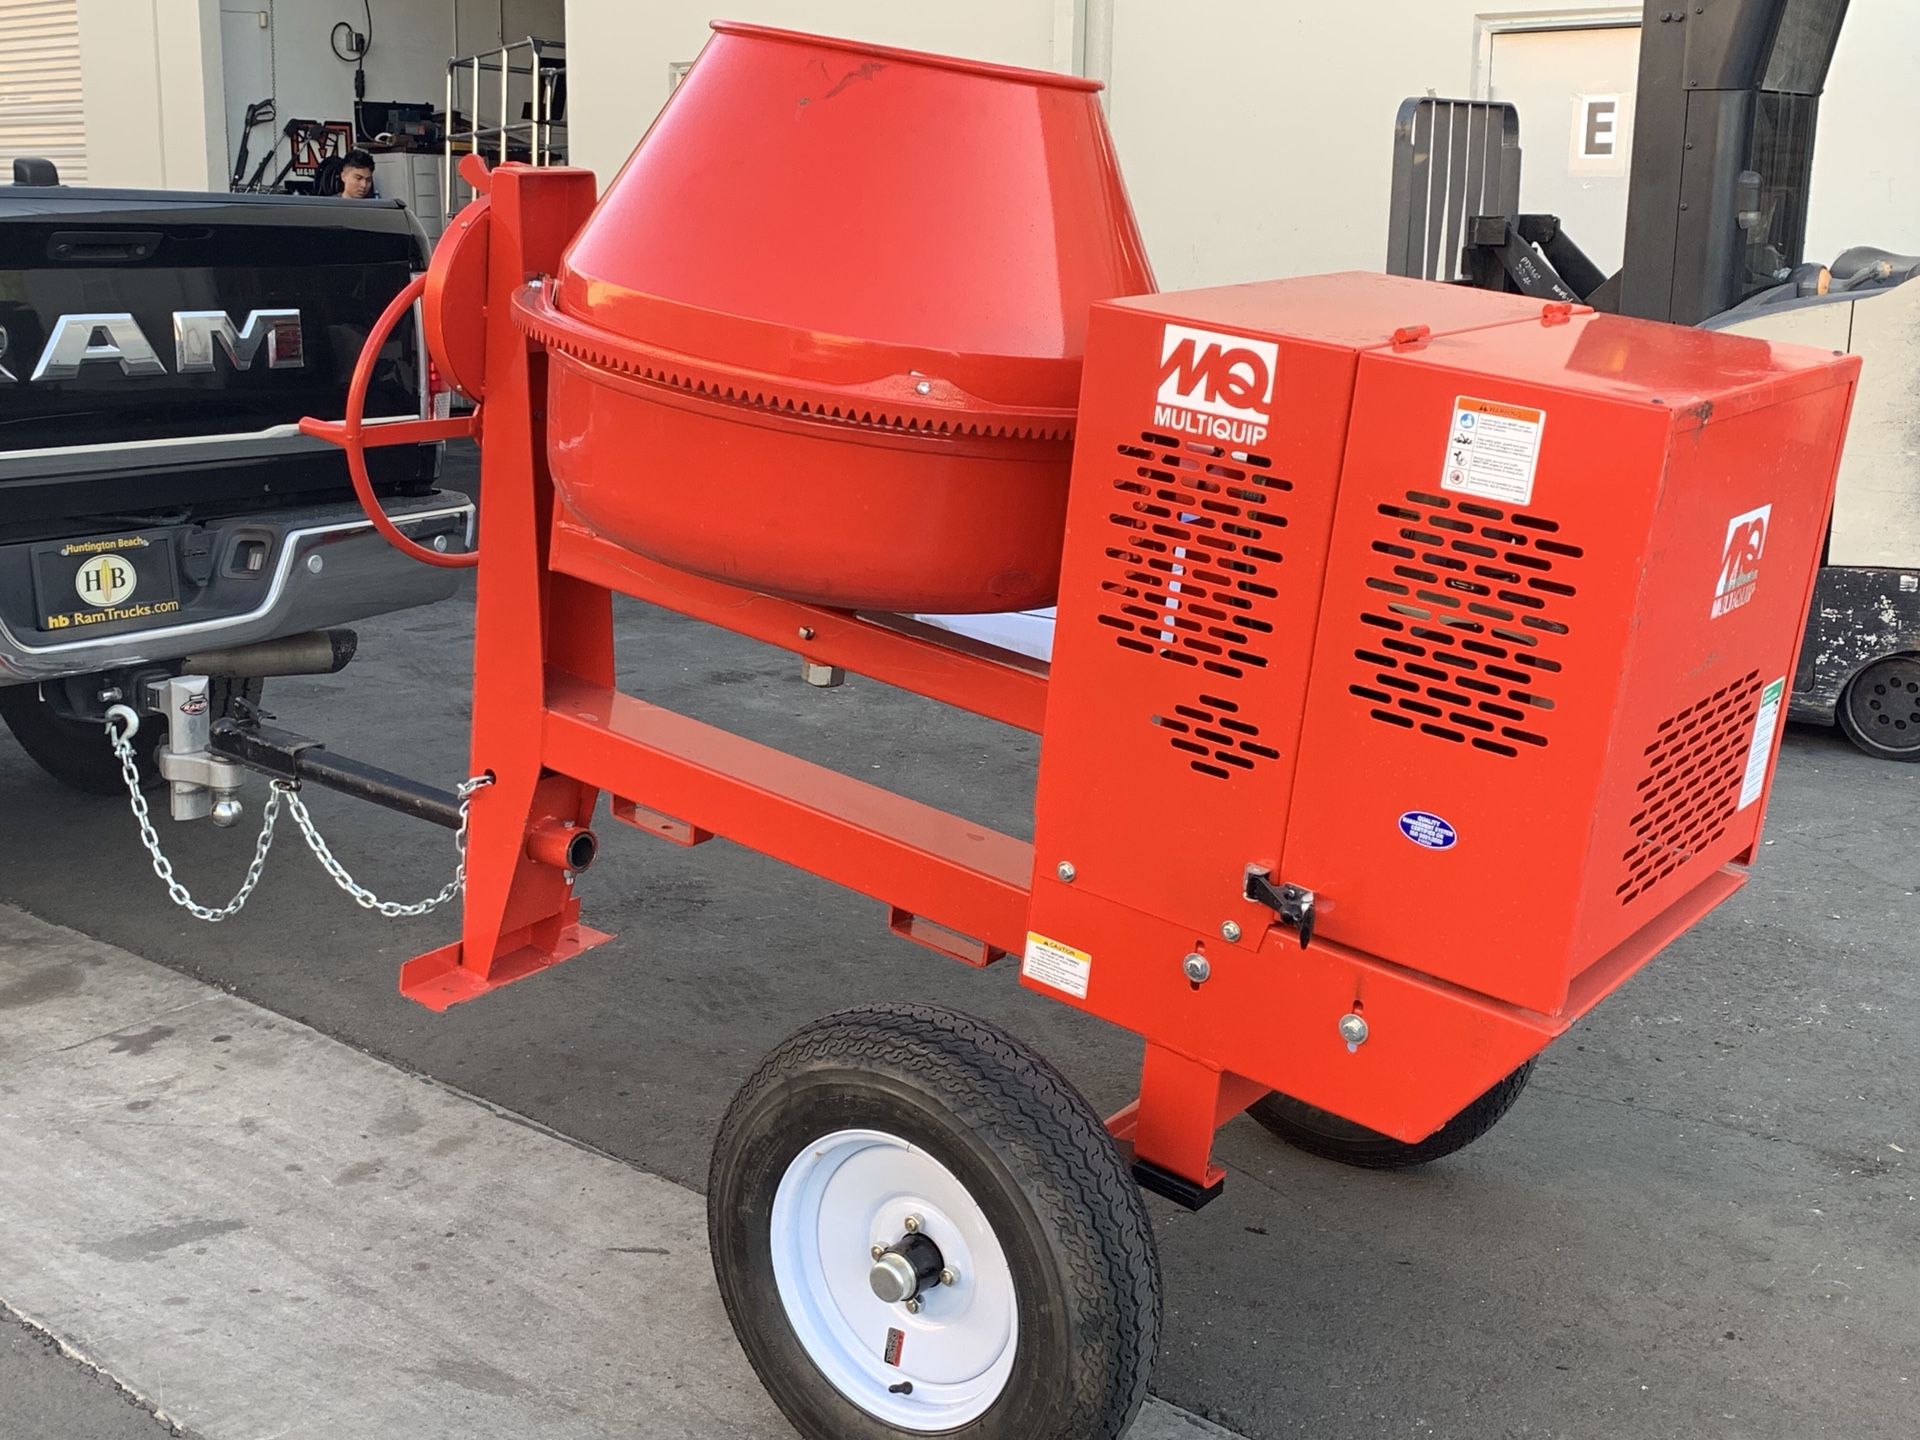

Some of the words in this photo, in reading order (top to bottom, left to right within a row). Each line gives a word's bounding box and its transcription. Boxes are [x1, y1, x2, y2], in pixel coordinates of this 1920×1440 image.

[1584, 101, 1616, 155] E
[1153, 405, 1268, 446] MULTIQUIP
[66, 540, 116, 555] Huntington
[118, 537, 144, 549] Beach
[48, 616, 70, 630] hb
